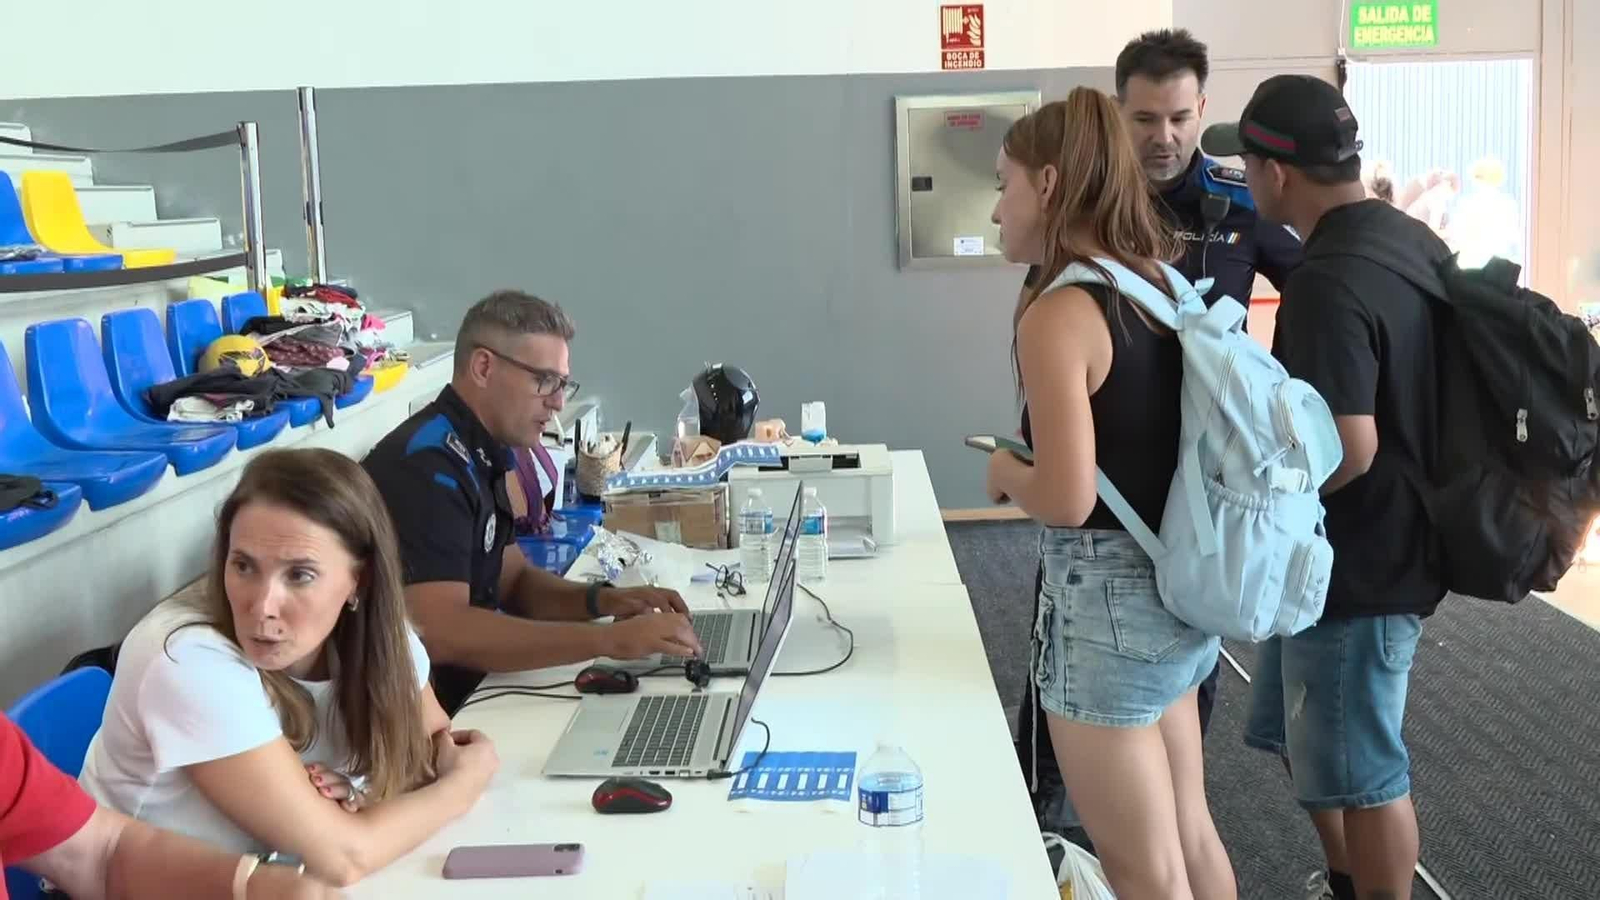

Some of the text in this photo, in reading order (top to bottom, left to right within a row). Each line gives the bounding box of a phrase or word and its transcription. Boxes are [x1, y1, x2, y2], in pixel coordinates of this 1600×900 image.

[1358, 4, 1432, 24] SALIDA DE
[1354, 25, 1434, 43] EMERGENCIA
[946, 51, 980, 61] BOCA DE
[944, 59, 982, 69] INCENDIO
